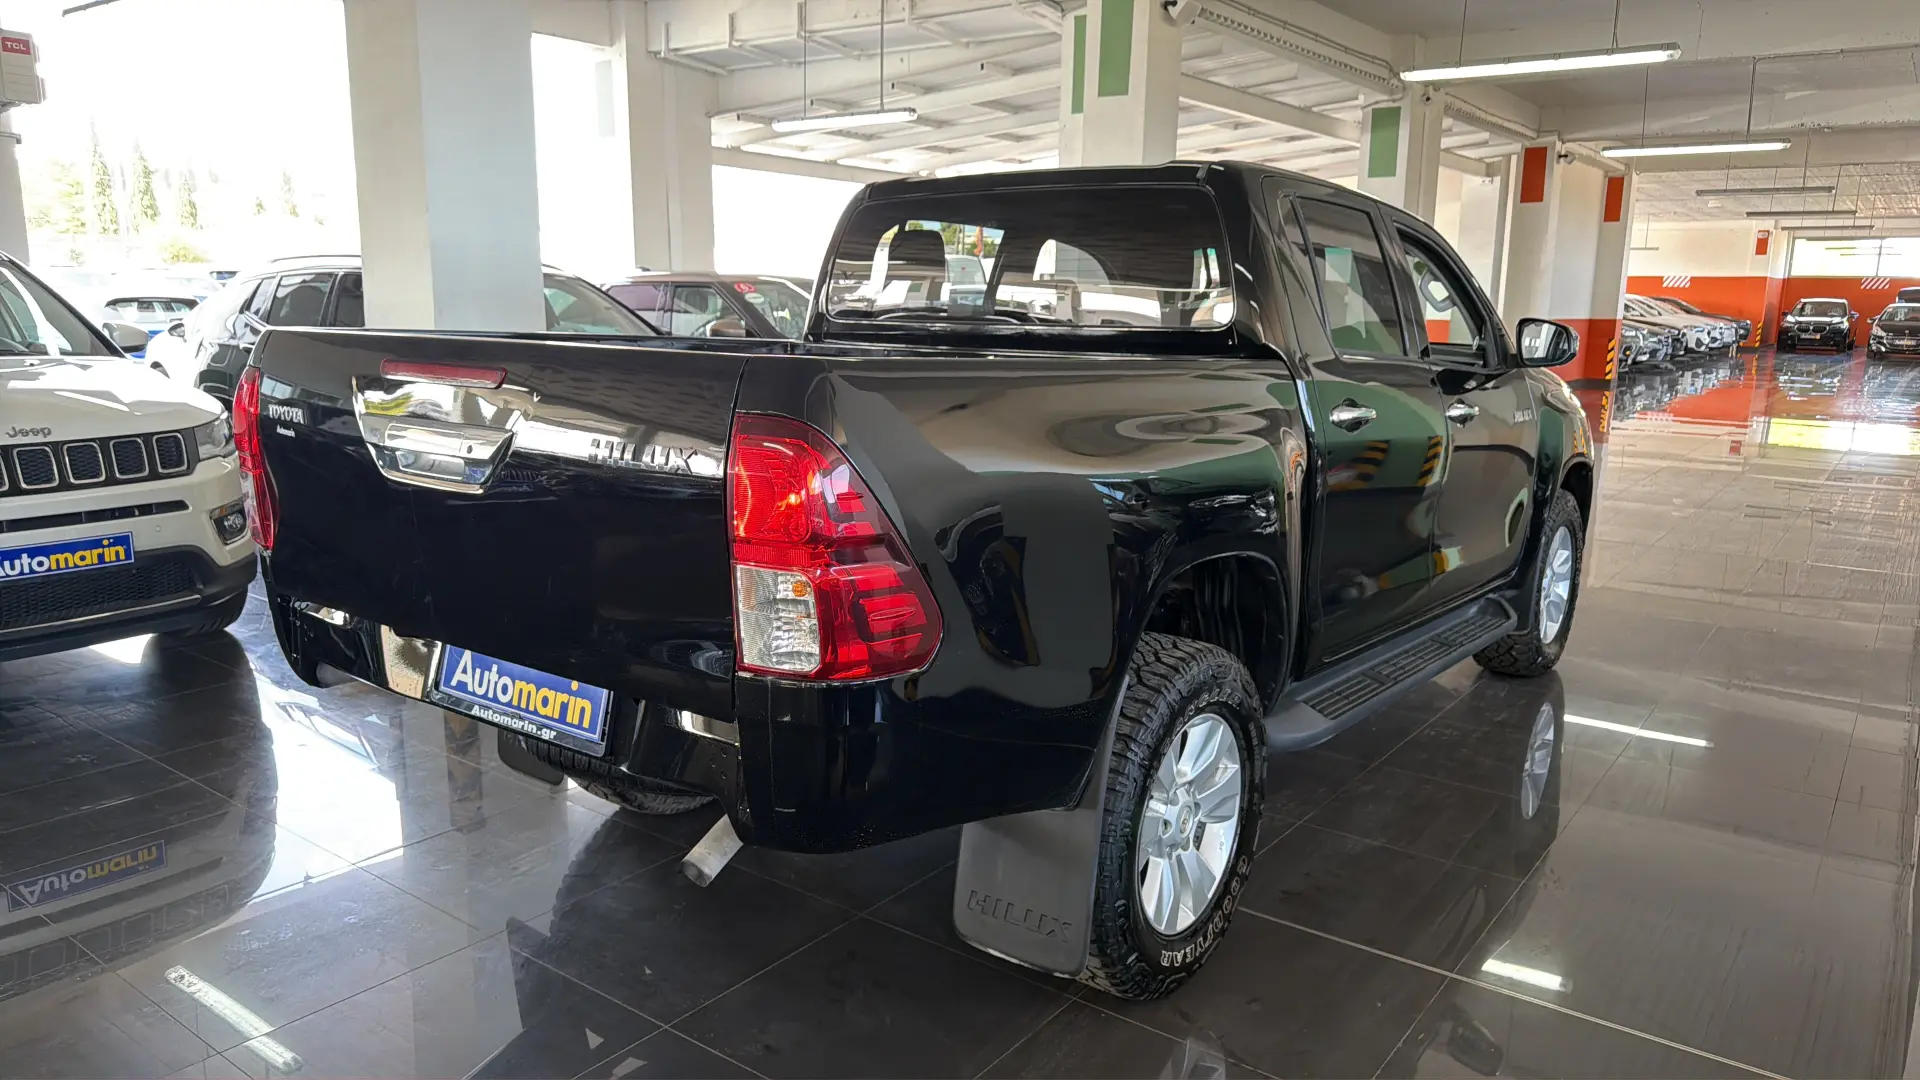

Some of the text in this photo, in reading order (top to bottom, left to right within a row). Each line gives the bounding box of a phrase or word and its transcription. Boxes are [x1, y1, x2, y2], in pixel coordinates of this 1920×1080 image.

[4, 41, 27, 51] TCL
[4, 426, 52, 438] Jeep
[268, 404, 305, 425] TOYOTA
[451, 649, 592, 729] Automarin
[470, 704, 557, 740] Automarin.gr
[967, 889, 1073, 944] HILUX
[1160, 855, 1248, 967] GOODYEAR
